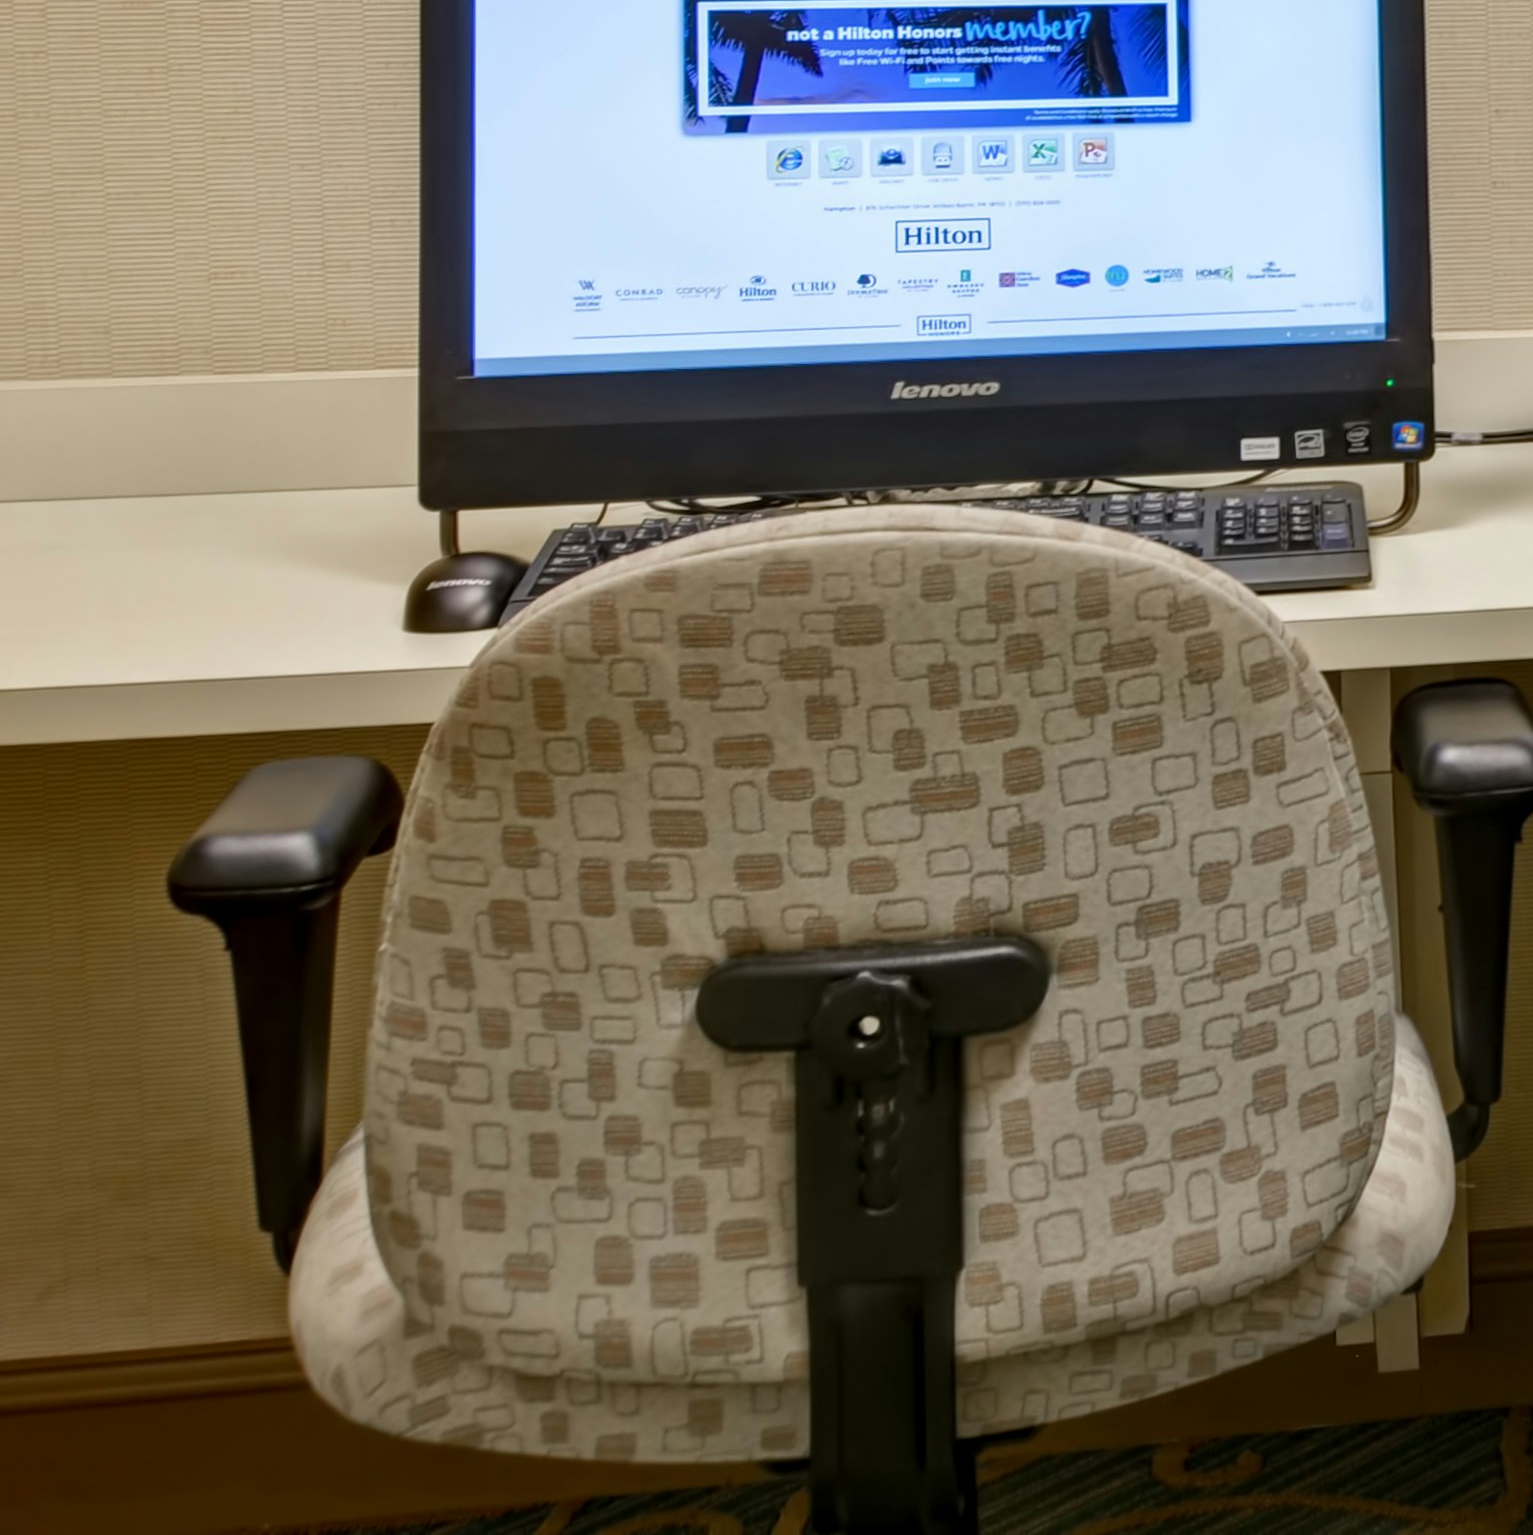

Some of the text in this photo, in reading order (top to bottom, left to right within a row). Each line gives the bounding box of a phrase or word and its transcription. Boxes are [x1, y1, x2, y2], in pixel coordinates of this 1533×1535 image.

[786, 9, 1092, 42] not a Hilton Honors member?
[819, 44, 1062, 58] Sign up today for free to start getting instant benefits
[838, 57, 855, 66] like
[857, 56, 879, 65] Free
[906, 56, 924, 65] and
[925, 55, 955, 65] Points
[956, 55, 993, 64] towards
[994, 54, 1012, 63] free
[903, 225, 983, 246] Hilton
[615, 288, 663, 297] CONRAD
[739, 287, 777, 298] Hilton
[791, 281, 836, 293] CURIO
[922, 319, 966, 330] Hilton
[890, 381, 1000, 399] lenovo
